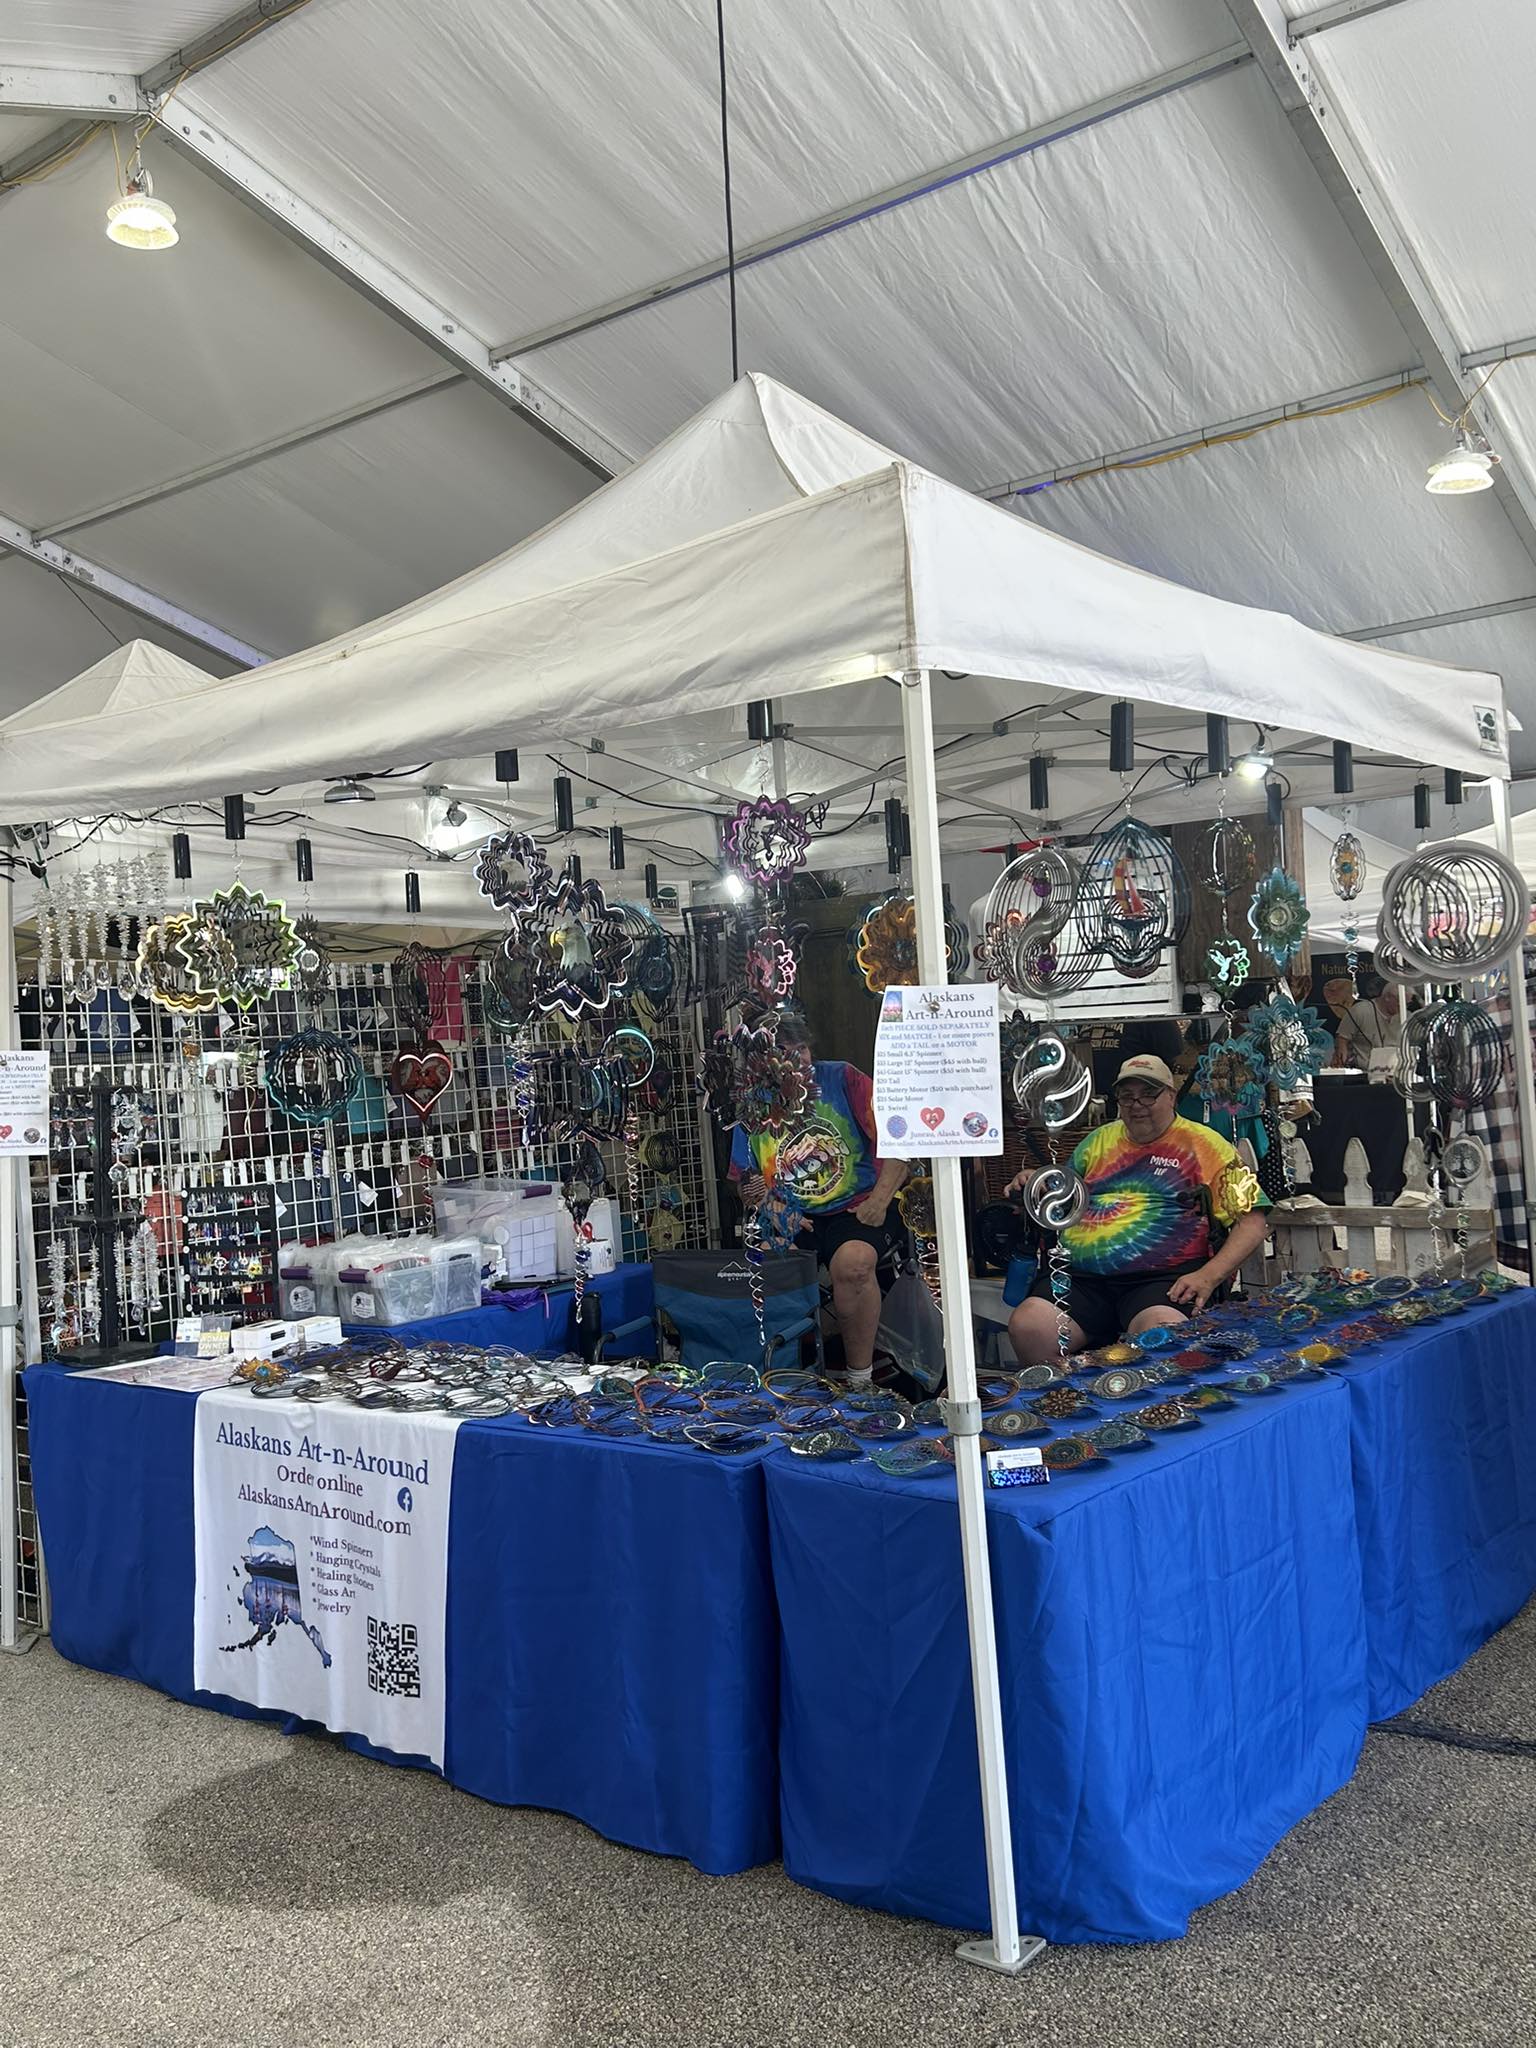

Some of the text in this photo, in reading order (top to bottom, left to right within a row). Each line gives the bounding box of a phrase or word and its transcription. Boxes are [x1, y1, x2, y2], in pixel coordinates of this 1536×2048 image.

[919, 991, 975, 1003] Alaskans
[906, 1006, 994, 1020] Art-n-Around
[939, 1021, 990, 1030] SEPARATELY
[946, 1040, 978, 1048] MOTOR
[938, 1130, 960, 1138] Alaska
[216, 1422, 429, 1485] Alaskans Art-n-Around
[317, 1474, 363, 1497] online
[238, 1483, 411, 1536] AlaskansArnAround.com
[313, 1535, 374, 1558] Wind Spinners
[316, 1551, 381, 1577] Hanging Crystals
[317, 1567, 353, 1585] Healing
